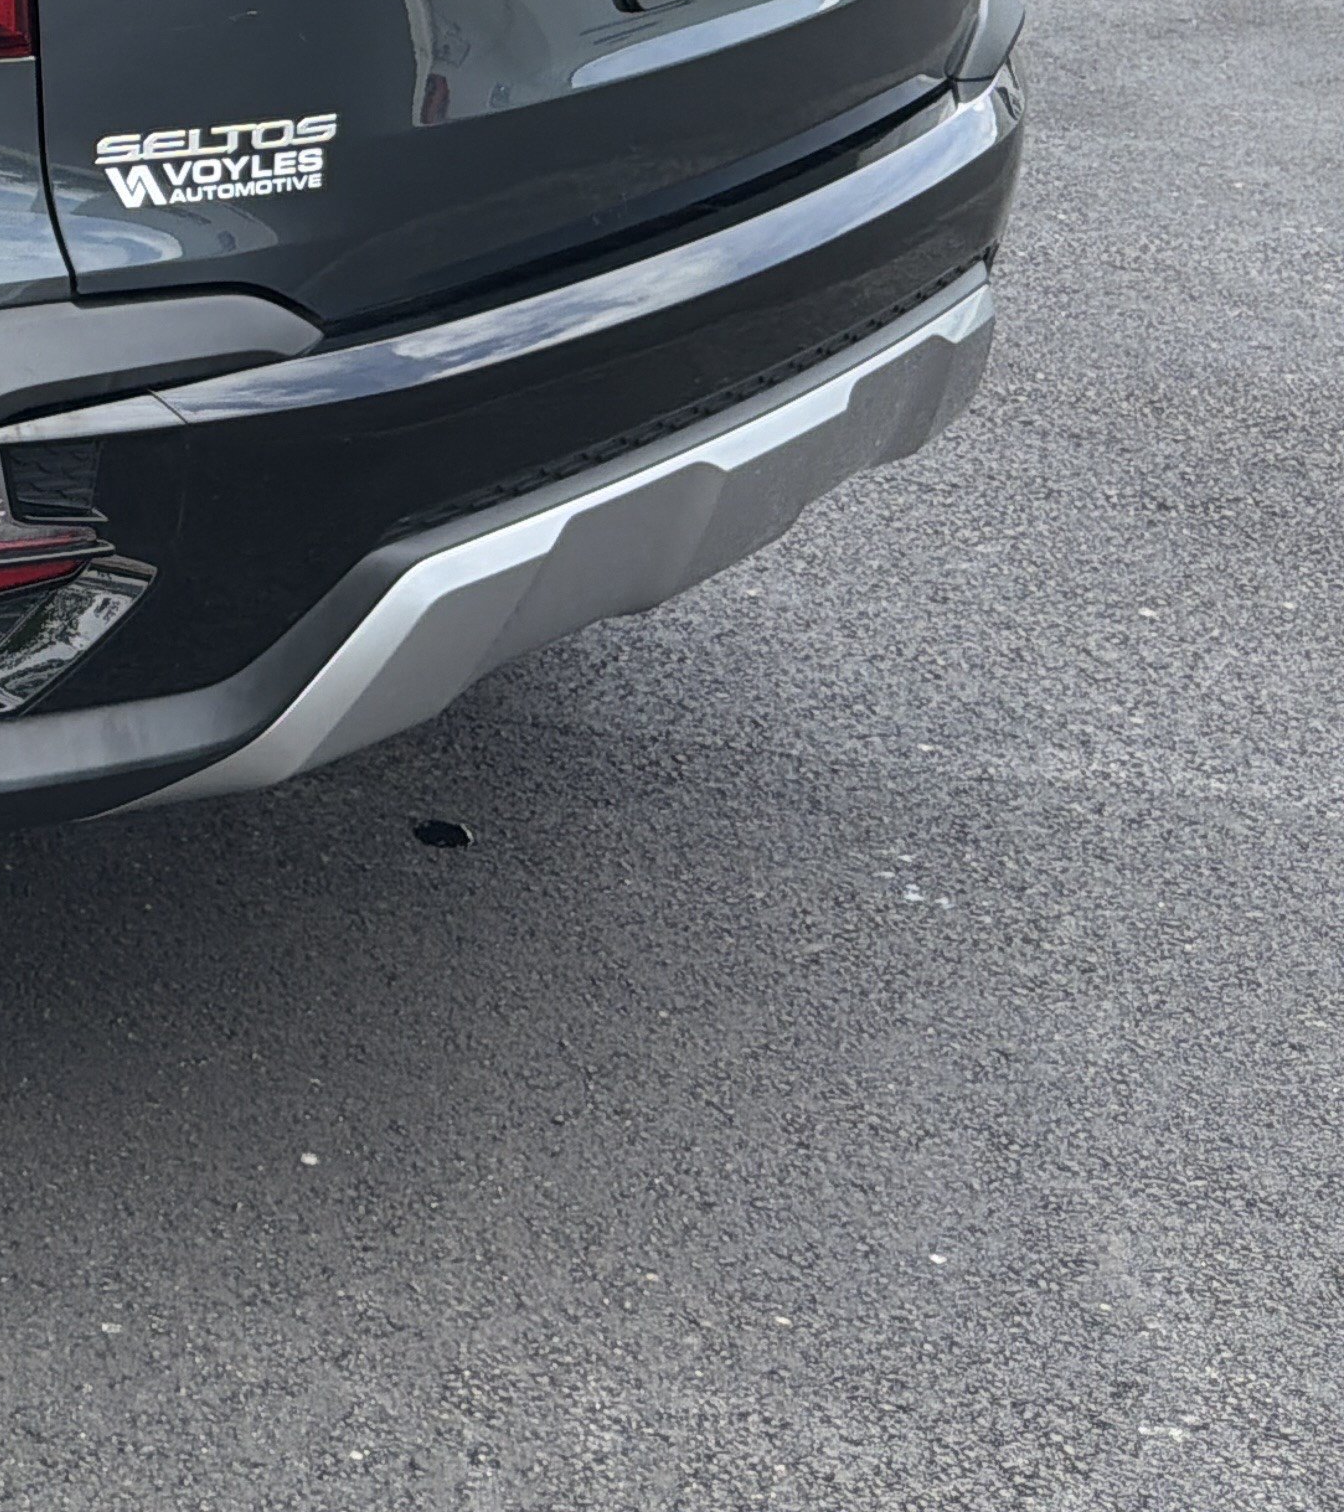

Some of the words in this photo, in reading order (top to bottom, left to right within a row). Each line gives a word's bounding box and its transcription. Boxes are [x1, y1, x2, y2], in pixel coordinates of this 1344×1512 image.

[94, 112, 338, 165] SELTOS
[162, 147, 324, 187] VOYLES
[168, 172, 323, 205] AUTOMOTIVE
